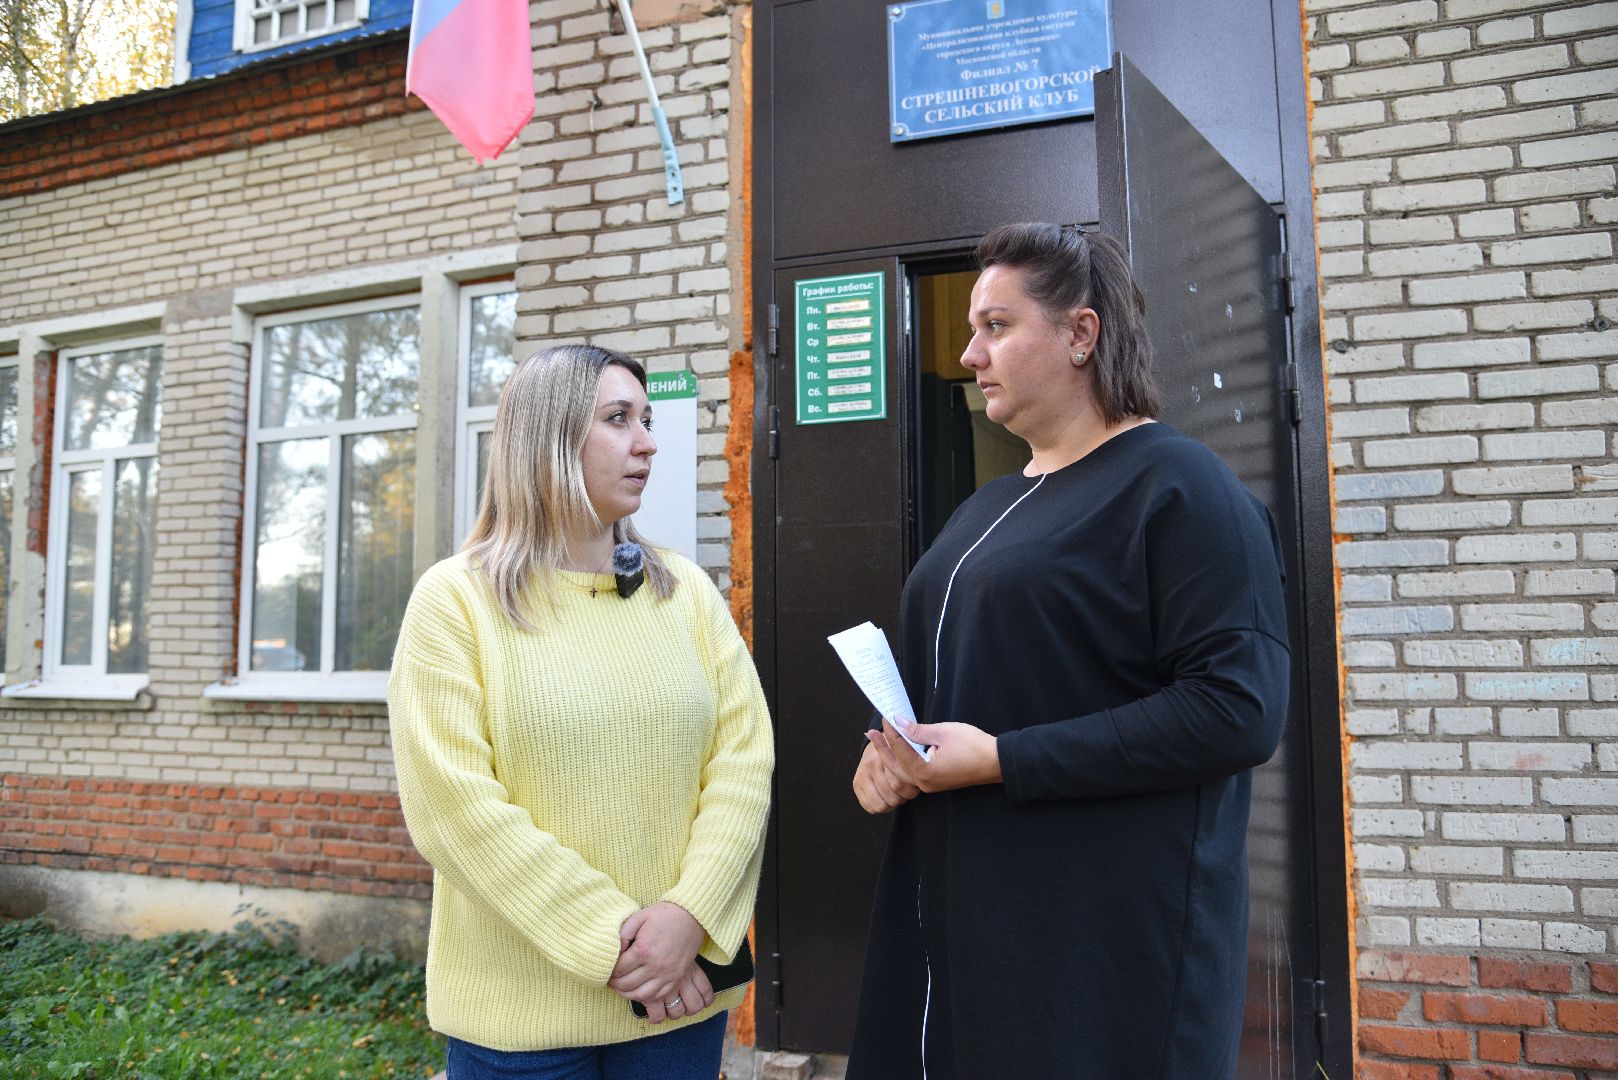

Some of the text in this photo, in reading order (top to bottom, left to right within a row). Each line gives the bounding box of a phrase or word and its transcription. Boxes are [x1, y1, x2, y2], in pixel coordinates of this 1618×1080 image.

[960, 58, 1040, 81] Филиал № 7
[924, 88, 1080, 124] СЕЛЬСКИЙ КЛУБ
[802, 282, 874, 297] График работы:
[806, 306, 821, 315] Пн.
[806, 322, 821, 331] Вт.
[806, 355, 821, 363] Чт.
[806, 371, 821, 380] Пт.
[807, 387, 823, 397] Сб.
[807, 404, 823, 413] Вс.
